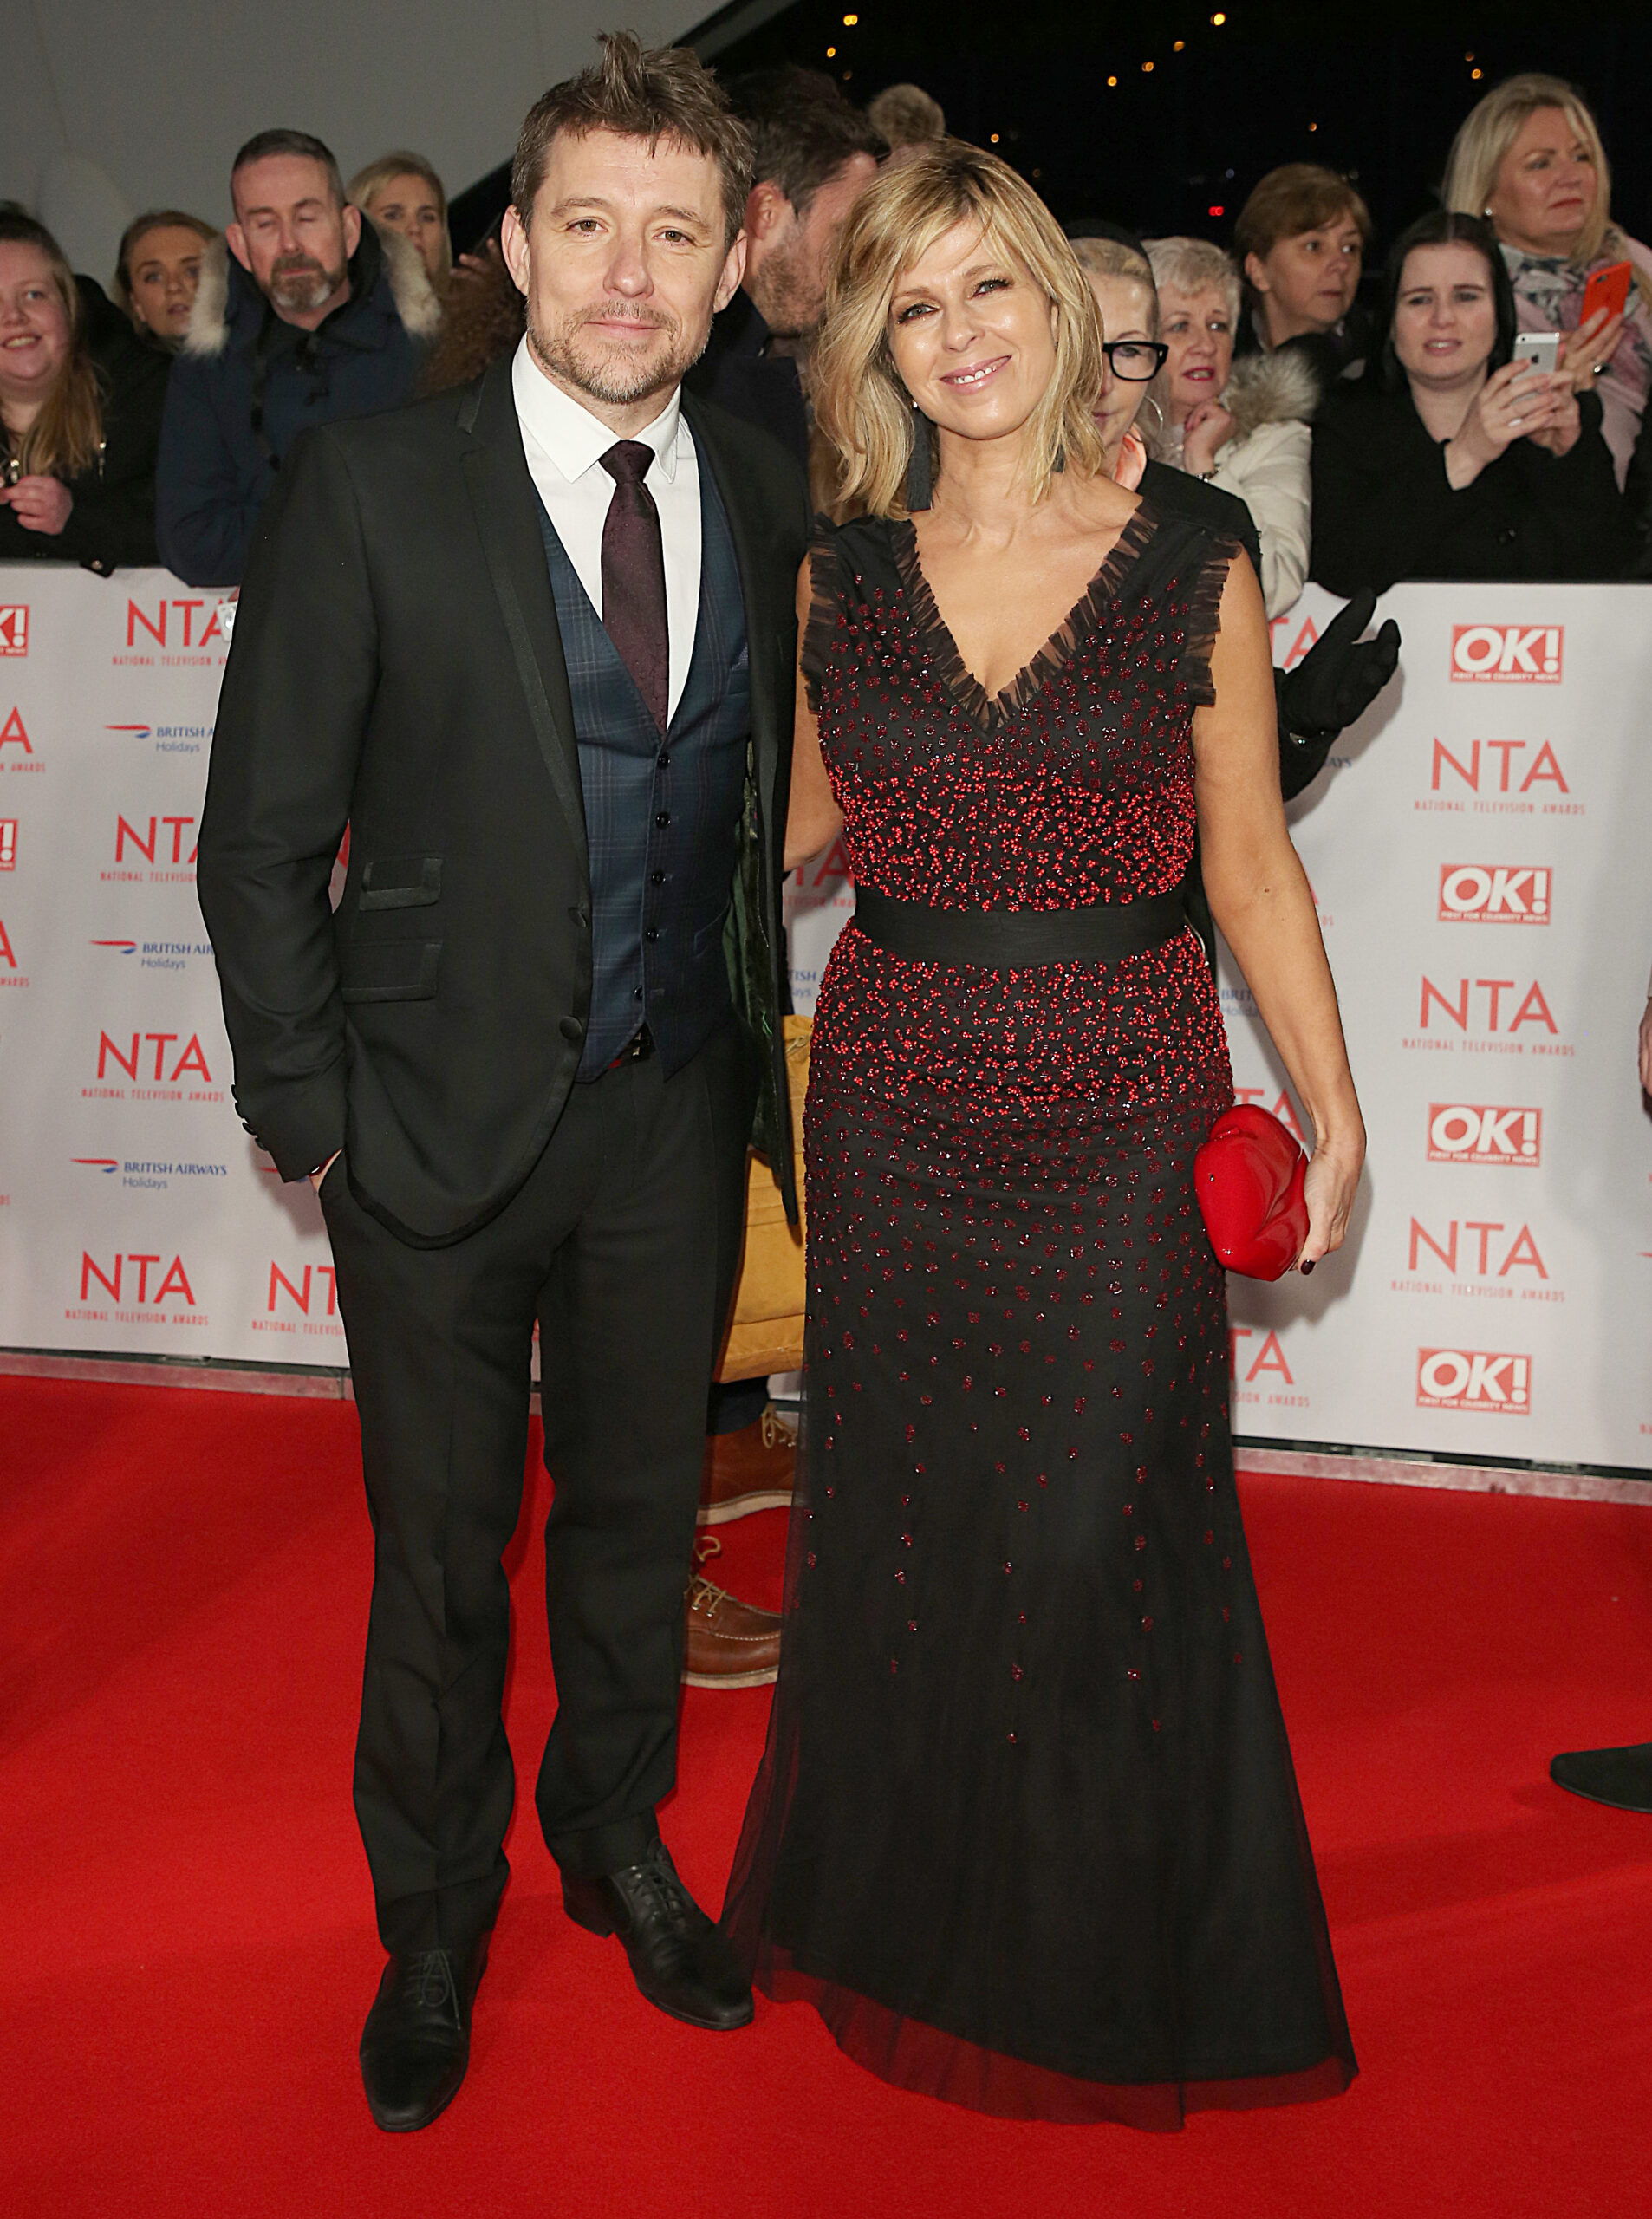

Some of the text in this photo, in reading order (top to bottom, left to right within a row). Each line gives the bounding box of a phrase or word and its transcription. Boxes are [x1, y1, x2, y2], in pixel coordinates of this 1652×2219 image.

[1454, 627, 1559, 673] OK!
[112, 656, 155, 667] NATIONAL
[161, 656, 211, 667] TELEVISION
[157, 726, 205, 738] BRITISH
[156, 742, 200, 753] Holidays
[1432, 737, 1569, 793] NTA
[1414, 800, 1585, 816] NATIONAL TELEVISION AWARDS
[115, 814, 198, 864] NT
[101, 871, 143, 882] NATIONAL
[1442, 867, 1547, 914] OK!
[142, 943, 191, 954] BRITISH
[141, 958, 186, 970] Holidays
[1420, 975, 1558, 1034] NTA
[97, 1030, 212, 1083] NTA
[1402, 1038, 1575, 1057] NATIONAL TELEVISION AWARDS
[81, 1088, 224, 1103] NATIONAL TELEVISION AWARDS
[1432, 1106, 1537, 1155] OK!
[124, 1162, 227, 1175] BRITISH AIRWAYS
[122, 1177, 168, 1190] Holidays
[1408, 1215, 1549, 1279] NTA
[81, 1250, 196, 1305] NTA
[268, 1260, 336, 1316] NT
[65, 1309, 209, 1326] NATIONAL TELEVISION AWARDS
[252, 1320, 296, 1333] NATIONAL
[1421, 1351, 1527, 1404] OK!
